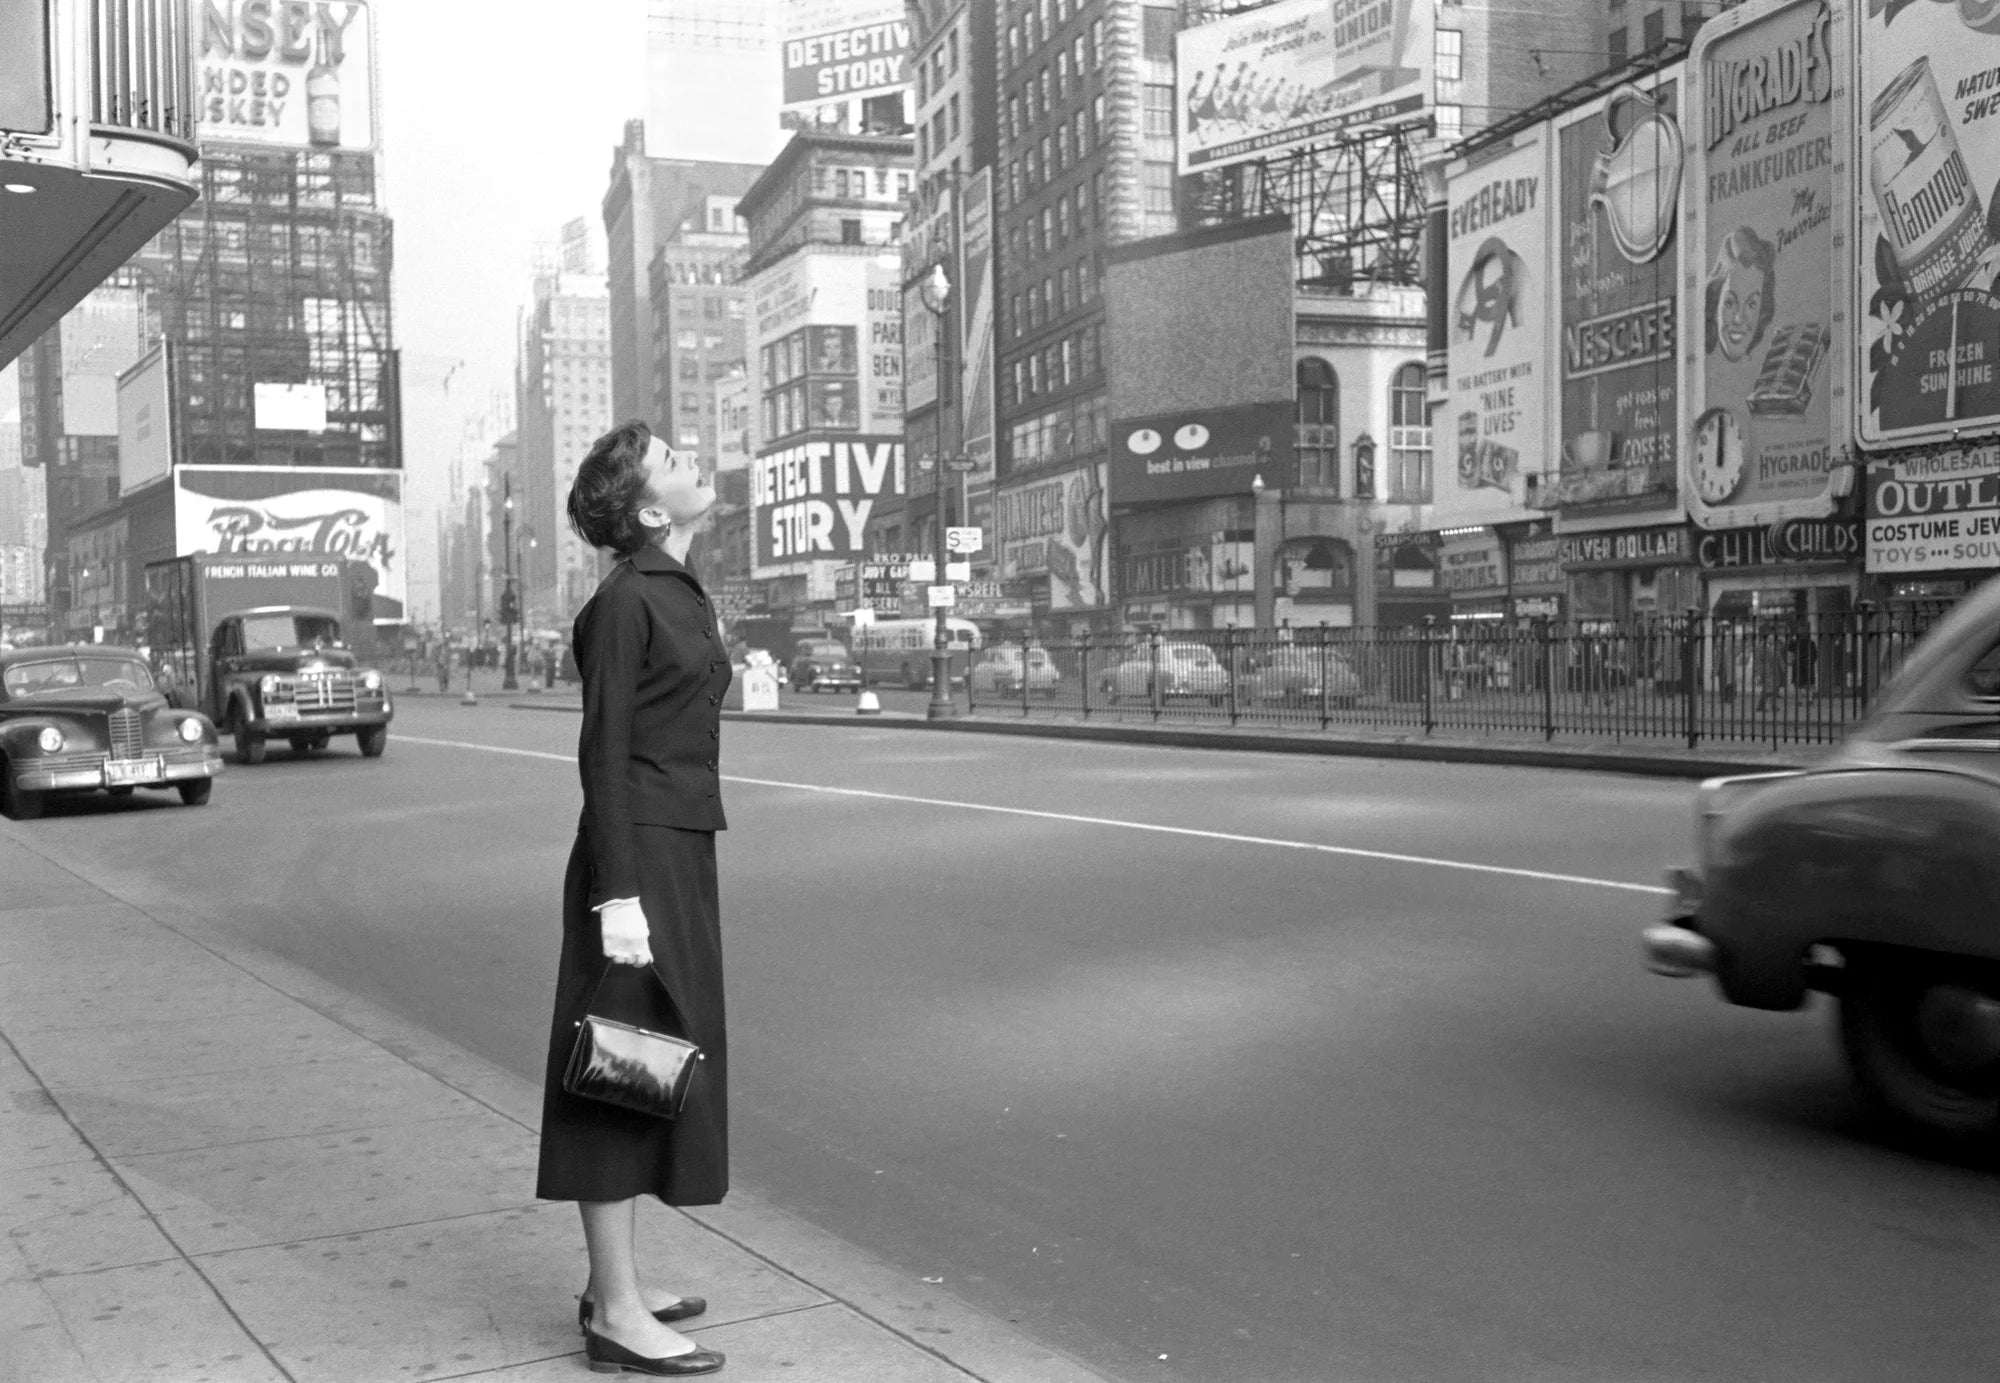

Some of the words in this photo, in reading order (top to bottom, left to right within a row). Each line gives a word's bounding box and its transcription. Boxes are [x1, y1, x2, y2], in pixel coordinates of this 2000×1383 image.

[818, 54, 905, 95] STORY
[1731, 131, 1761, 159] ALL
[1765, 112, 1809, 146] BEEF
[1451, 176, 1540, 240] EVEREADY
[1884, 149, 1969, 249] Flamingo
[1912, 249, 1958, 294] ORANGE
[1957, 216, 1987, 262] JUICE
[1938, 294, 1949, 308] 40
[1963, 290, 1975, 303] 60
[1975, 291, 1988, 305] 70
[1456, 377, 1472, 393] THE
[1473, 365, 1508, 390] BATTERY
[1510, 360, 1533, 380] WITH
[1920, 364, 1993, 394] SUNHINE
[1147, 456, 1172, 475] best
[1173, 456, 1184, 473] in
[1185, 454, 1210, 472] view
[1623, 432, 1671, 467] COFFEE
[772, 499, 873, 558] STORY
[1786, 522, 1858, 553] CHILDS
[1872, 519, 1959, 542] COSTUME
[873, 553, 899, 565] RKO
[1561, 540, 1610, 566] SILVER
[1616, 530, 1679, 558] DOLLAR
[205, 565, 245, 579] FRENCH
[247, 564, 287, 579] ITALIAN
[290, 563, 318, 579] WINE
